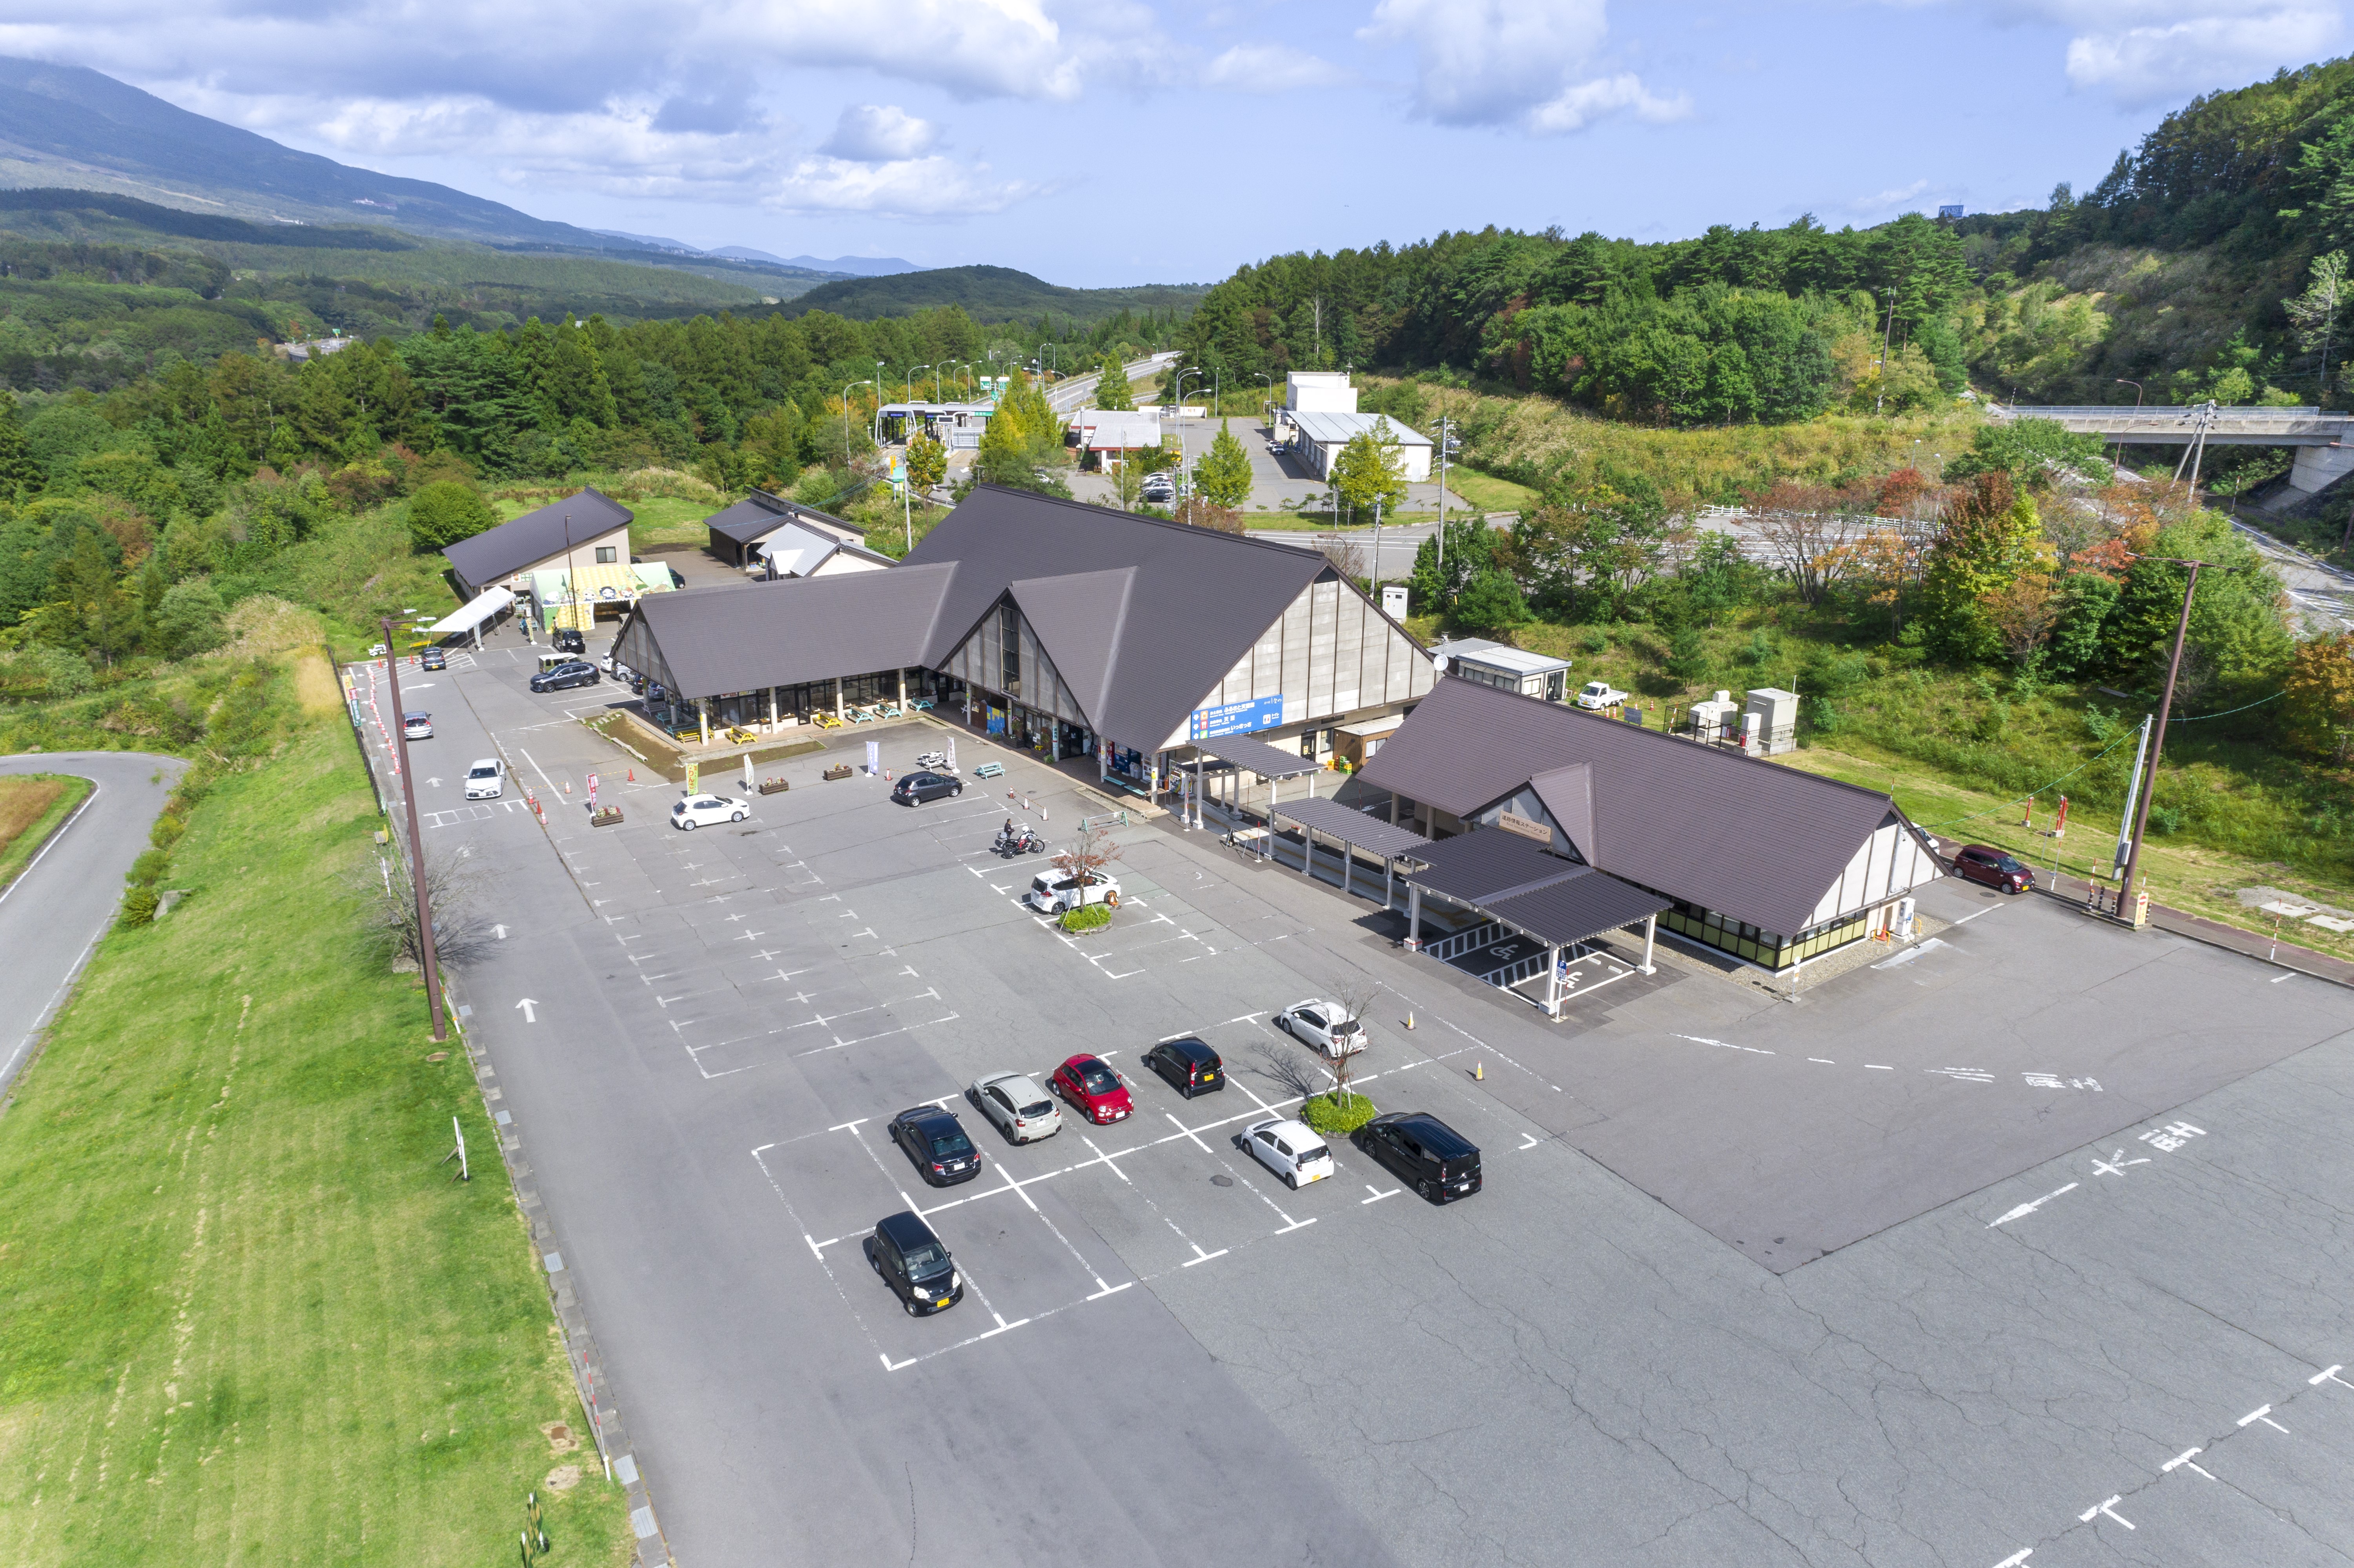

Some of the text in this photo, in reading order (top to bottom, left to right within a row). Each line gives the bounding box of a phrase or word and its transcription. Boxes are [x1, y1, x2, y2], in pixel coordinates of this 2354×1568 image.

[1502, 815, 1547, 834] 道路情報ステーション
